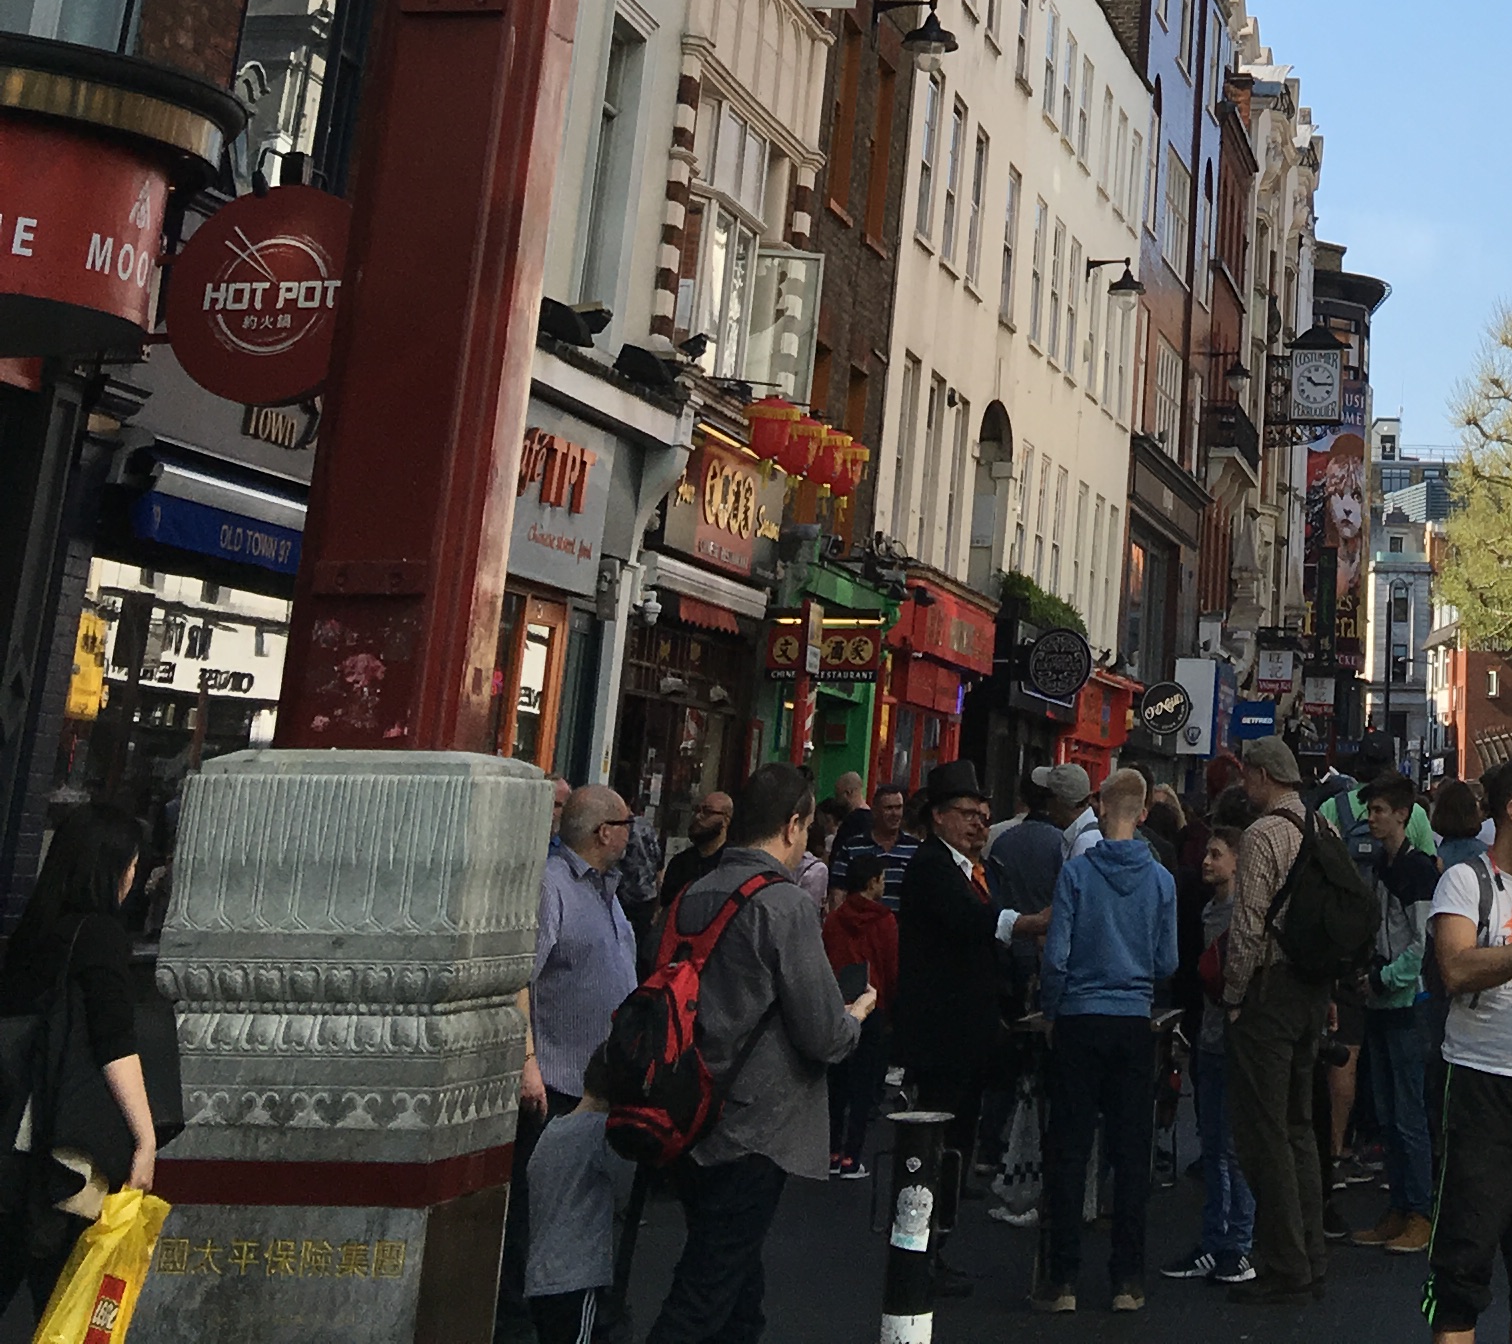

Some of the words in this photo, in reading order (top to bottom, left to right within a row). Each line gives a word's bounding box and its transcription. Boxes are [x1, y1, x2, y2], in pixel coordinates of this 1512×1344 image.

[202, 282, 270, 311] HOT
[276, 280, 342, 310] POT
[543, 435, 598, 514] TPT
[220, 525, 243, 552] OLD
[246, 530, 278, 561] TOWN
[278, 540, 292, 564] 97
[776, 635, 871, 663] 文酒家
[771, 670, 796, 679] CHINE
[1241, 716, 1273, 724] BETFRED
[155, 1236, 408, 1280] 國太平保險集團
